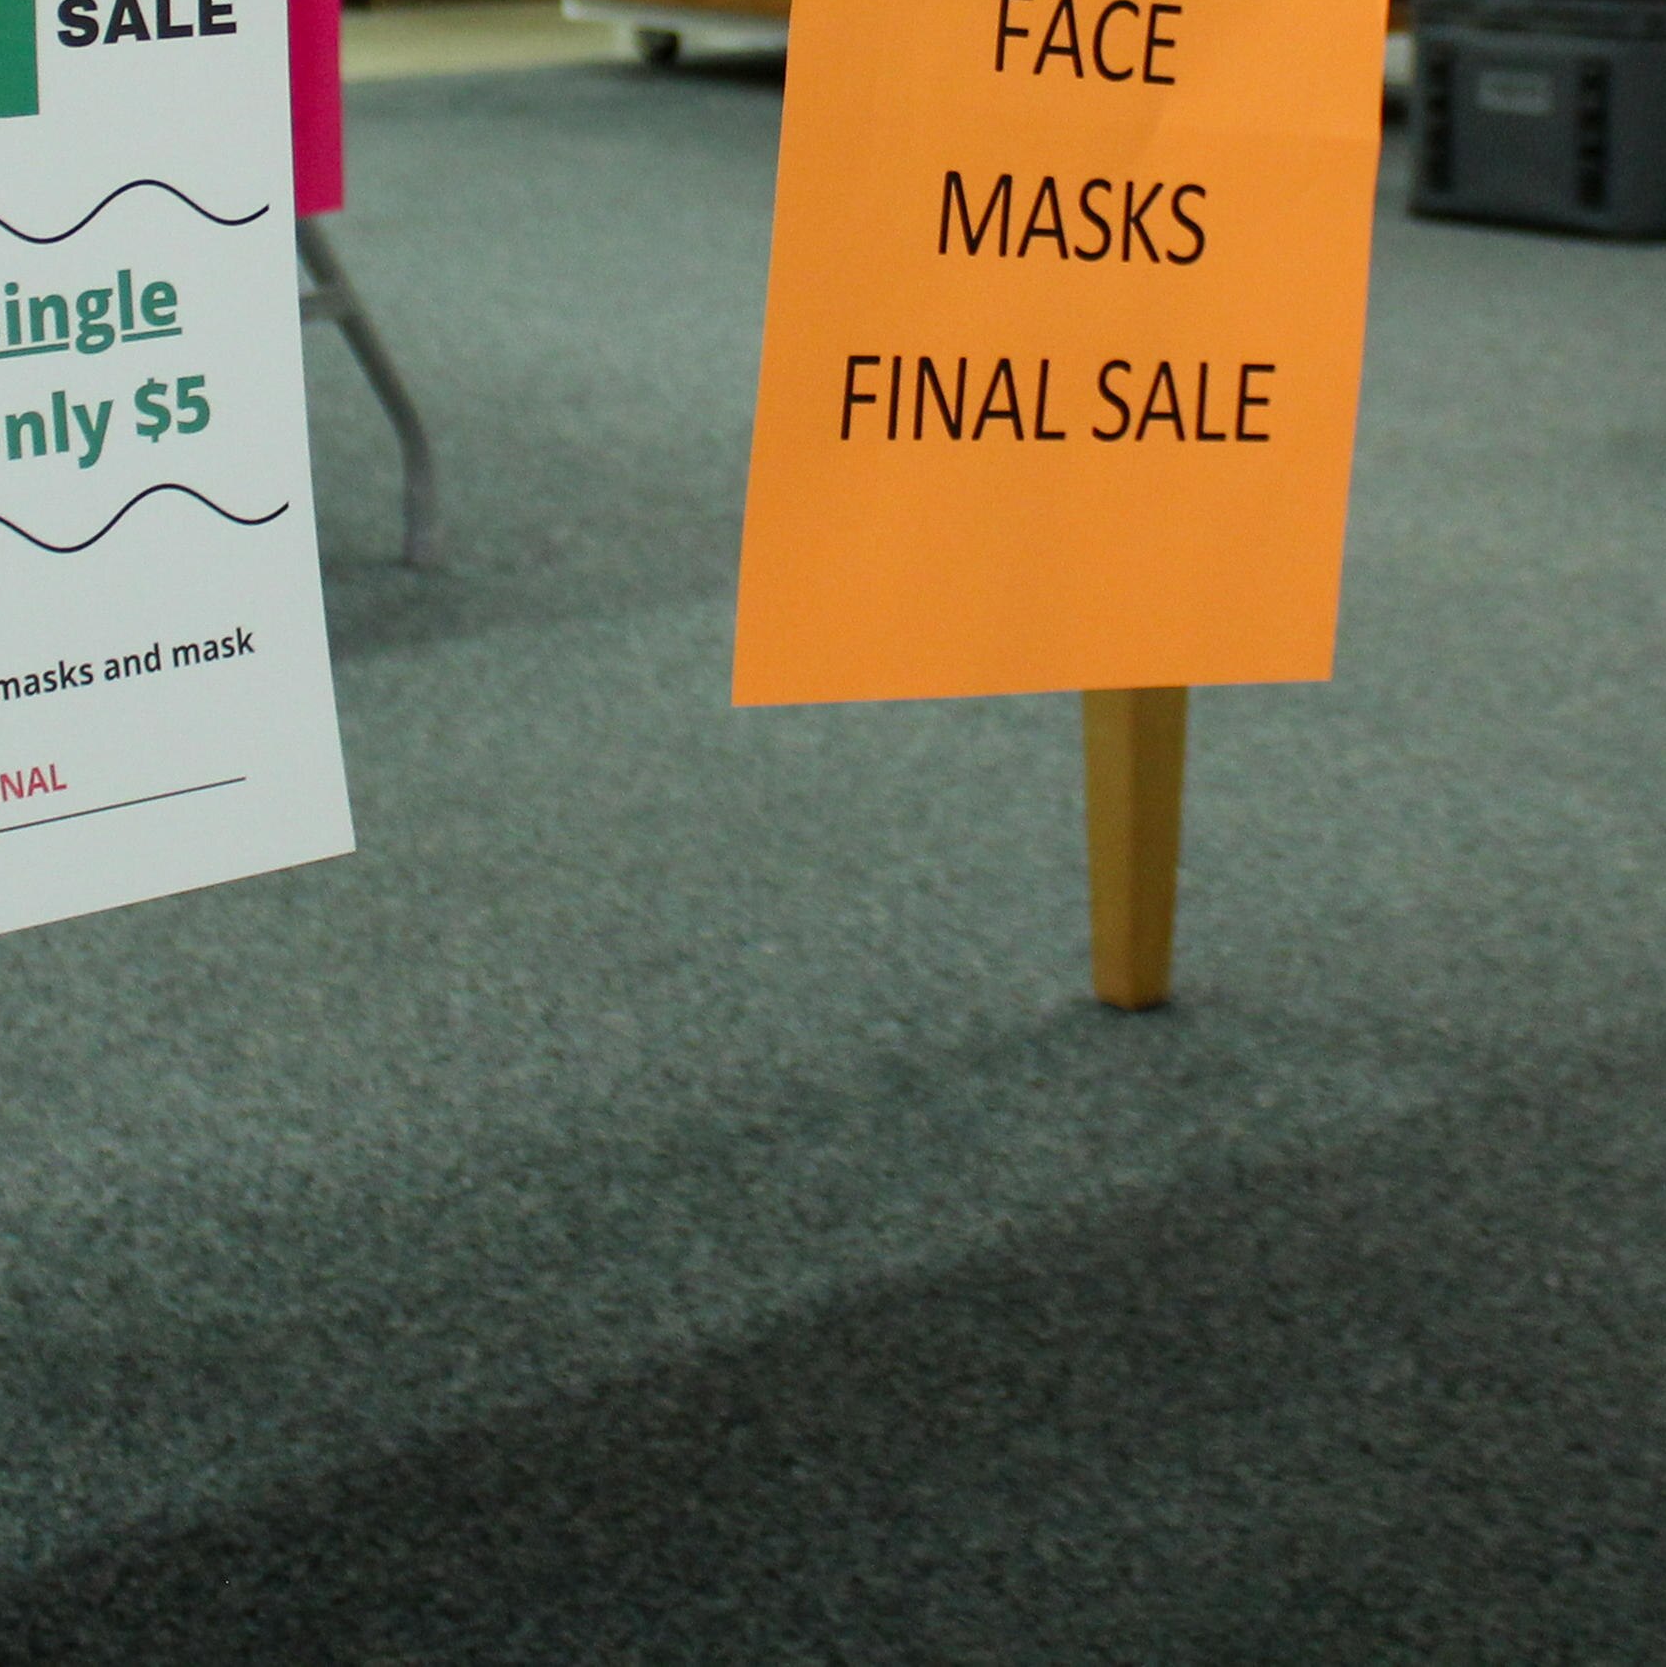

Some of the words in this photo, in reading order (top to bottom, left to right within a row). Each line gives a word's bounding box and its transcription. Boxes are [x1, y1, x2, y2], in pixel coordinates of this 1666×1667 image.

[938, 171, 1206, 265] MASKS
[134, 374, 211, 443] $5
[840, 355, 1066, 442] FINAL
[1092, 360, 1276, 443] SALE
[103, 644, 163, 681] and
[172, 627, 255, 670] mask
